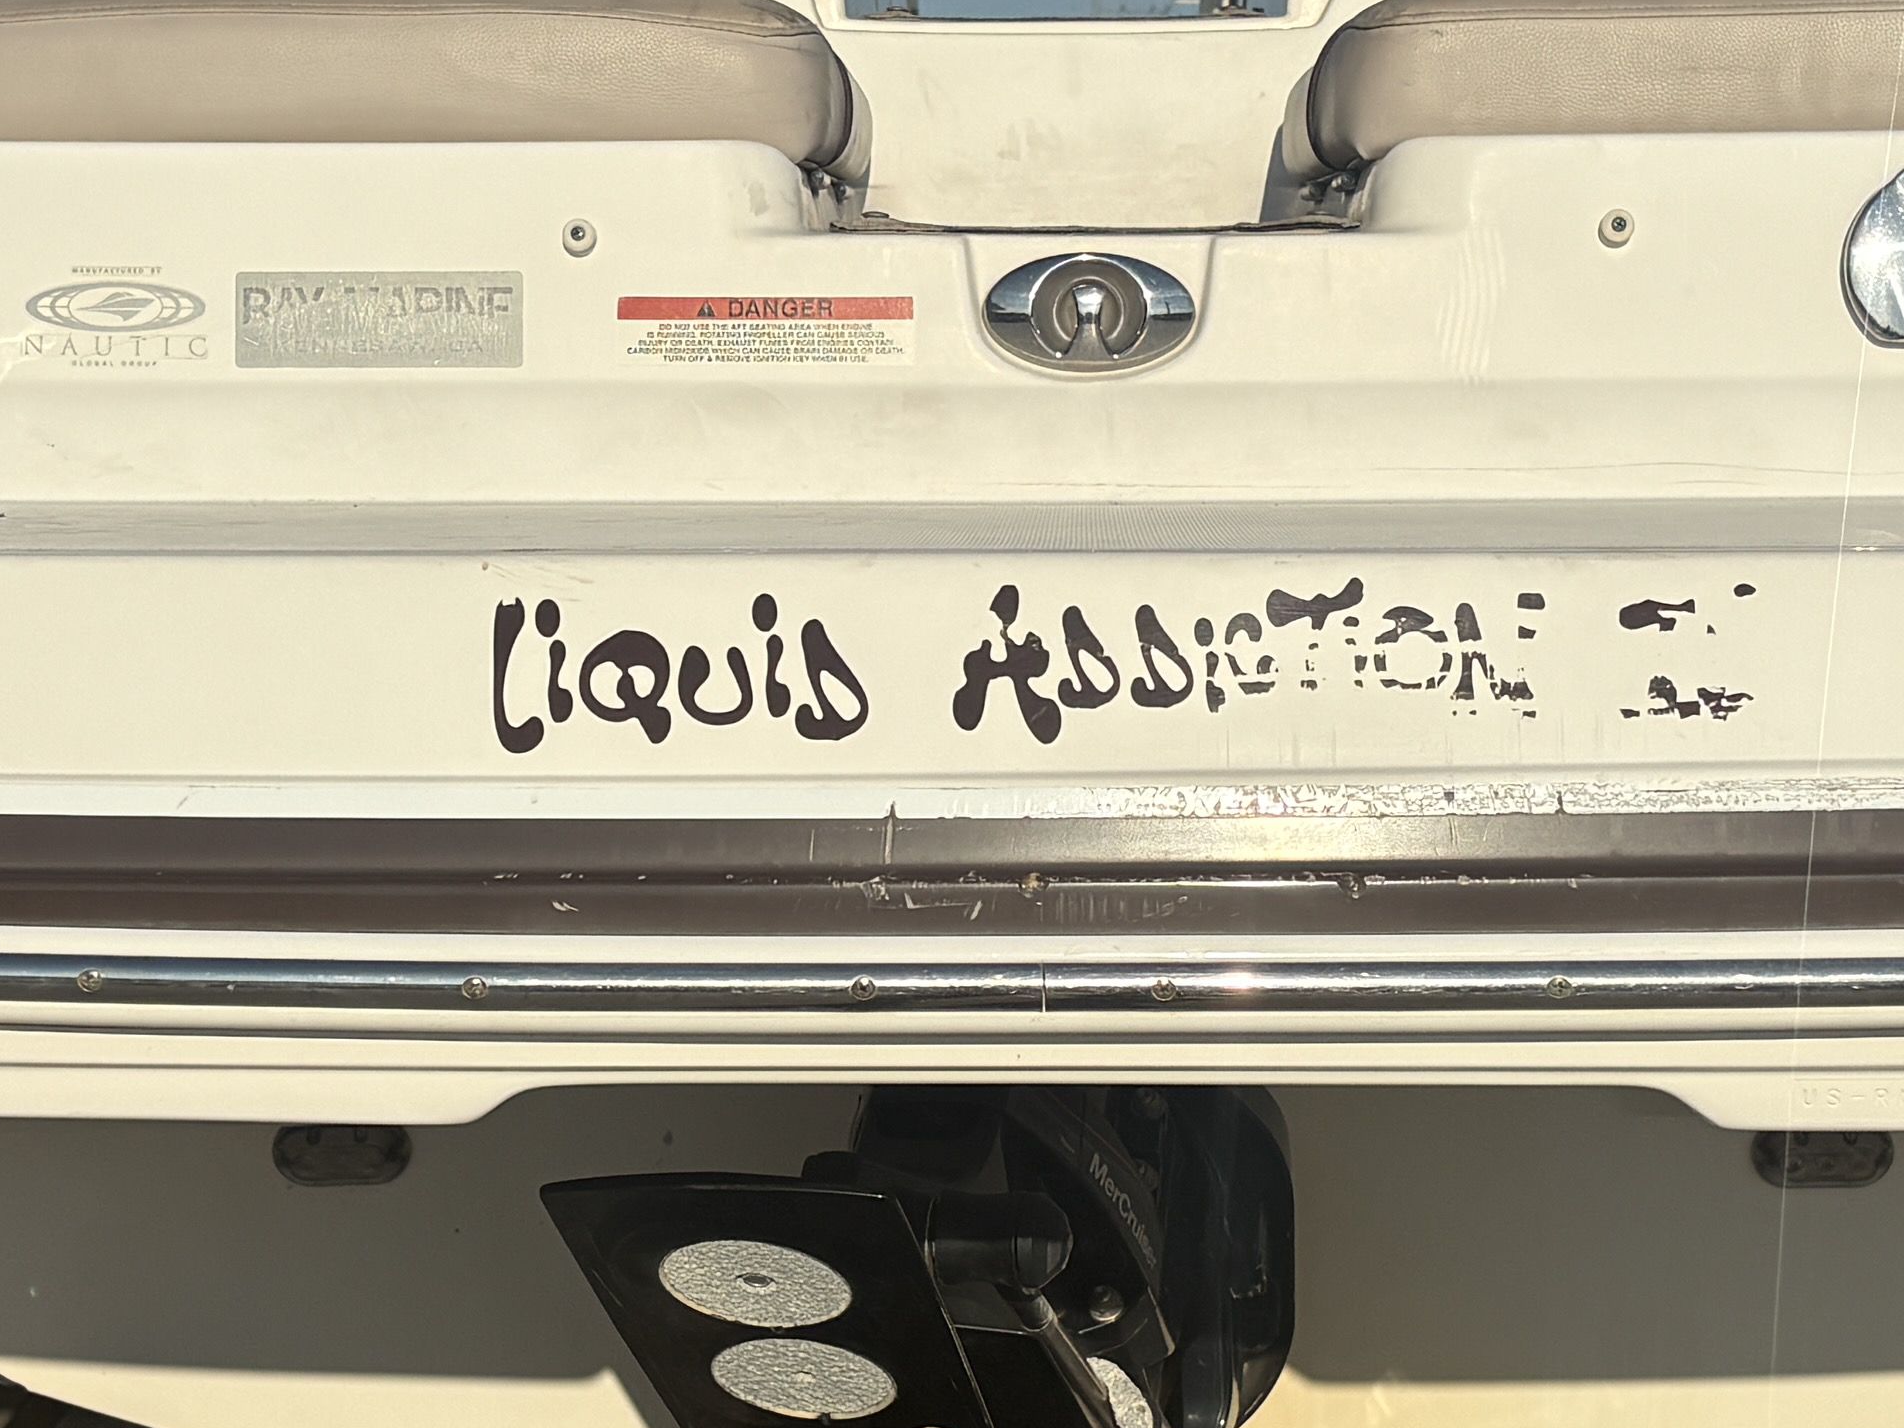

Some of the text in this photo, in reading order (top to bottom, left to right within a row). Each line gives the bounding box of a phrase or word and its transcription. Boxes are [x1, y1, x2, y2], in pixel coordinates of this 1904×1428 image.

[71, 266, 145, 275] MANUFACTURED
[728, 299, 834, 318] DANGER
[24, 333, 207, 358] NAUTIC
[71, 359, 158, 368] GLOBAL GROUP
